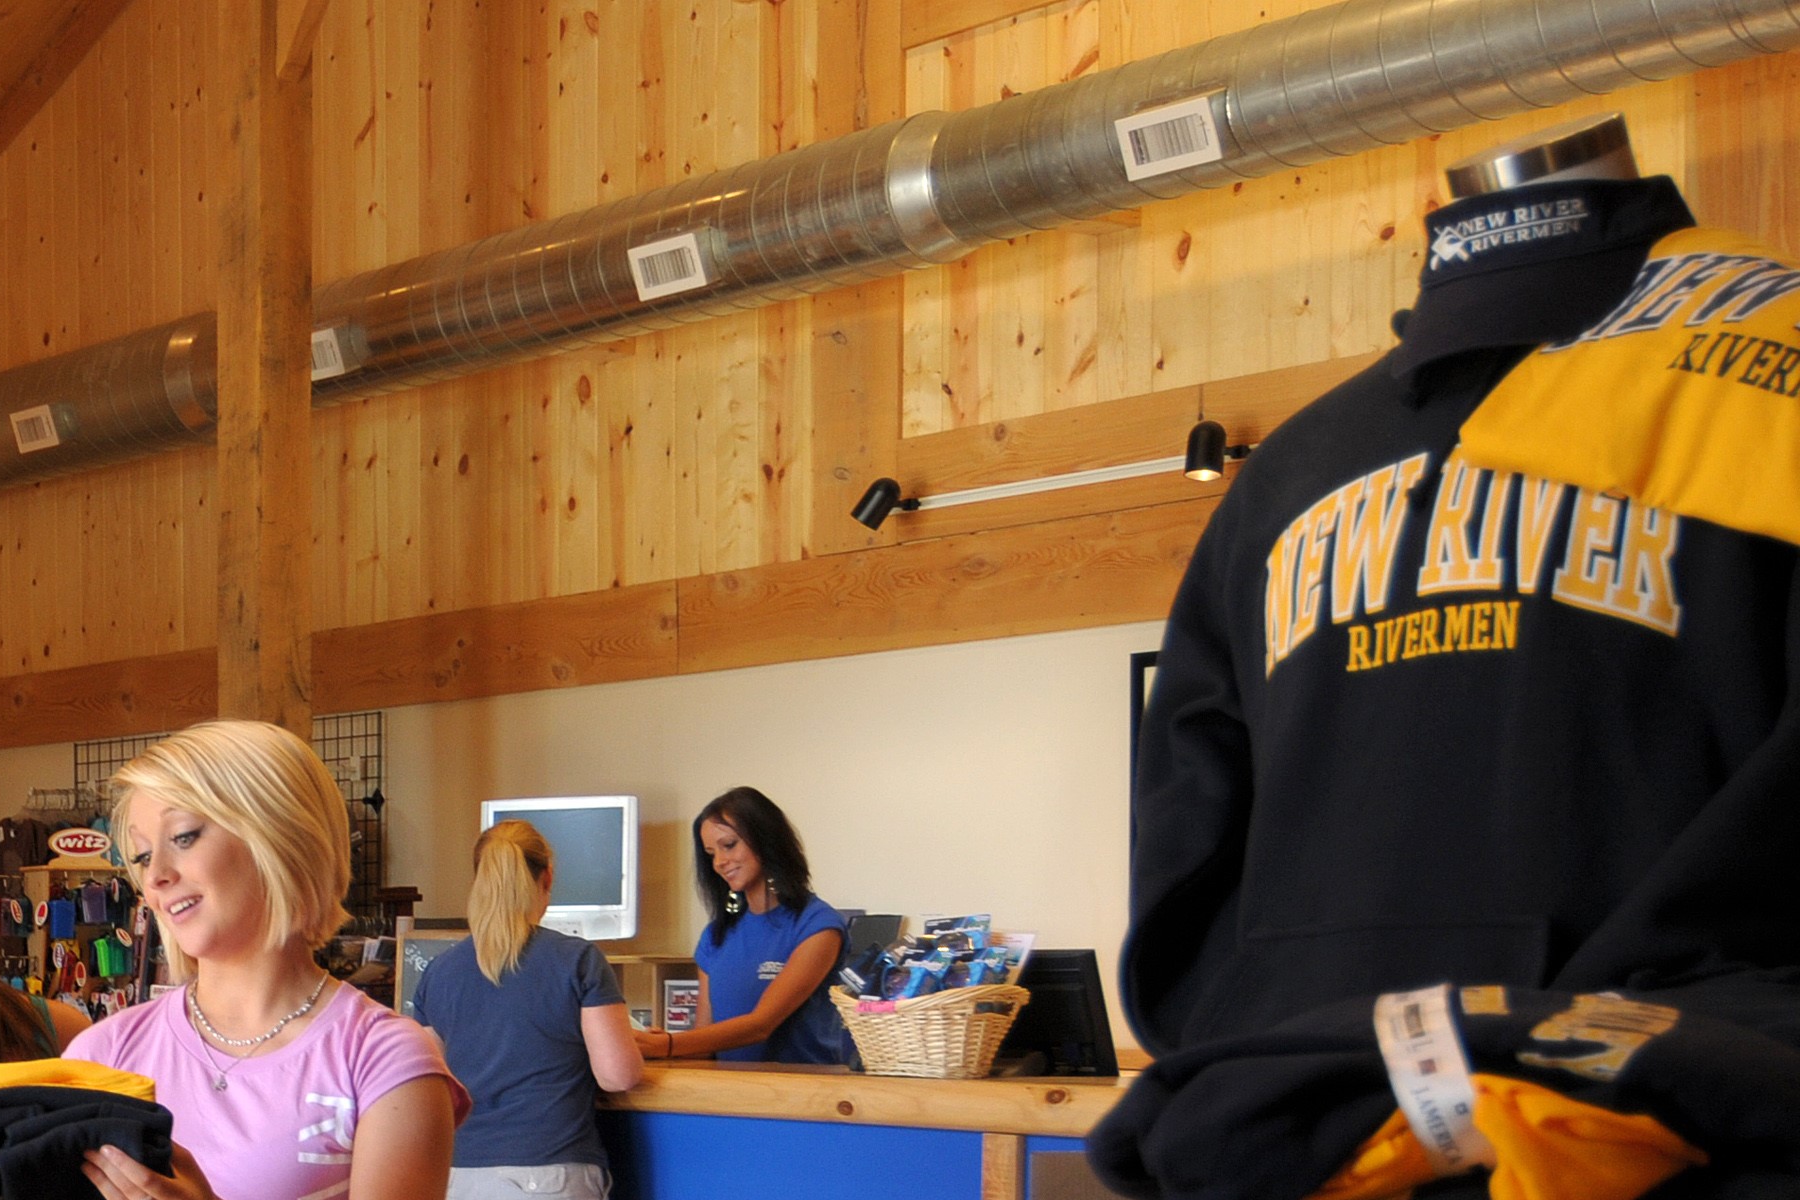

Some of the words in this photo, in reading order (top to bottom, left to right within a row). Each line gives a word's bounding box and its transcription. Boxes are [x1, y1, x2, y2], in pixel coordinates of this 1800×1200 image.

[1460, 211, 1508, 236] NEW
[1513, 198, 1587, 224] RIVER
[1470, 219, 1581, 253] RIVERMEN
[1667, 331, 1800, 398] RIVER
[1264, 451, 1431, 682] NEW
[1416, 443, 1682, 638] RIVER
[1345, 600, 1521, 672] RIVERMEN
[58, 834, 107, 849] witz
